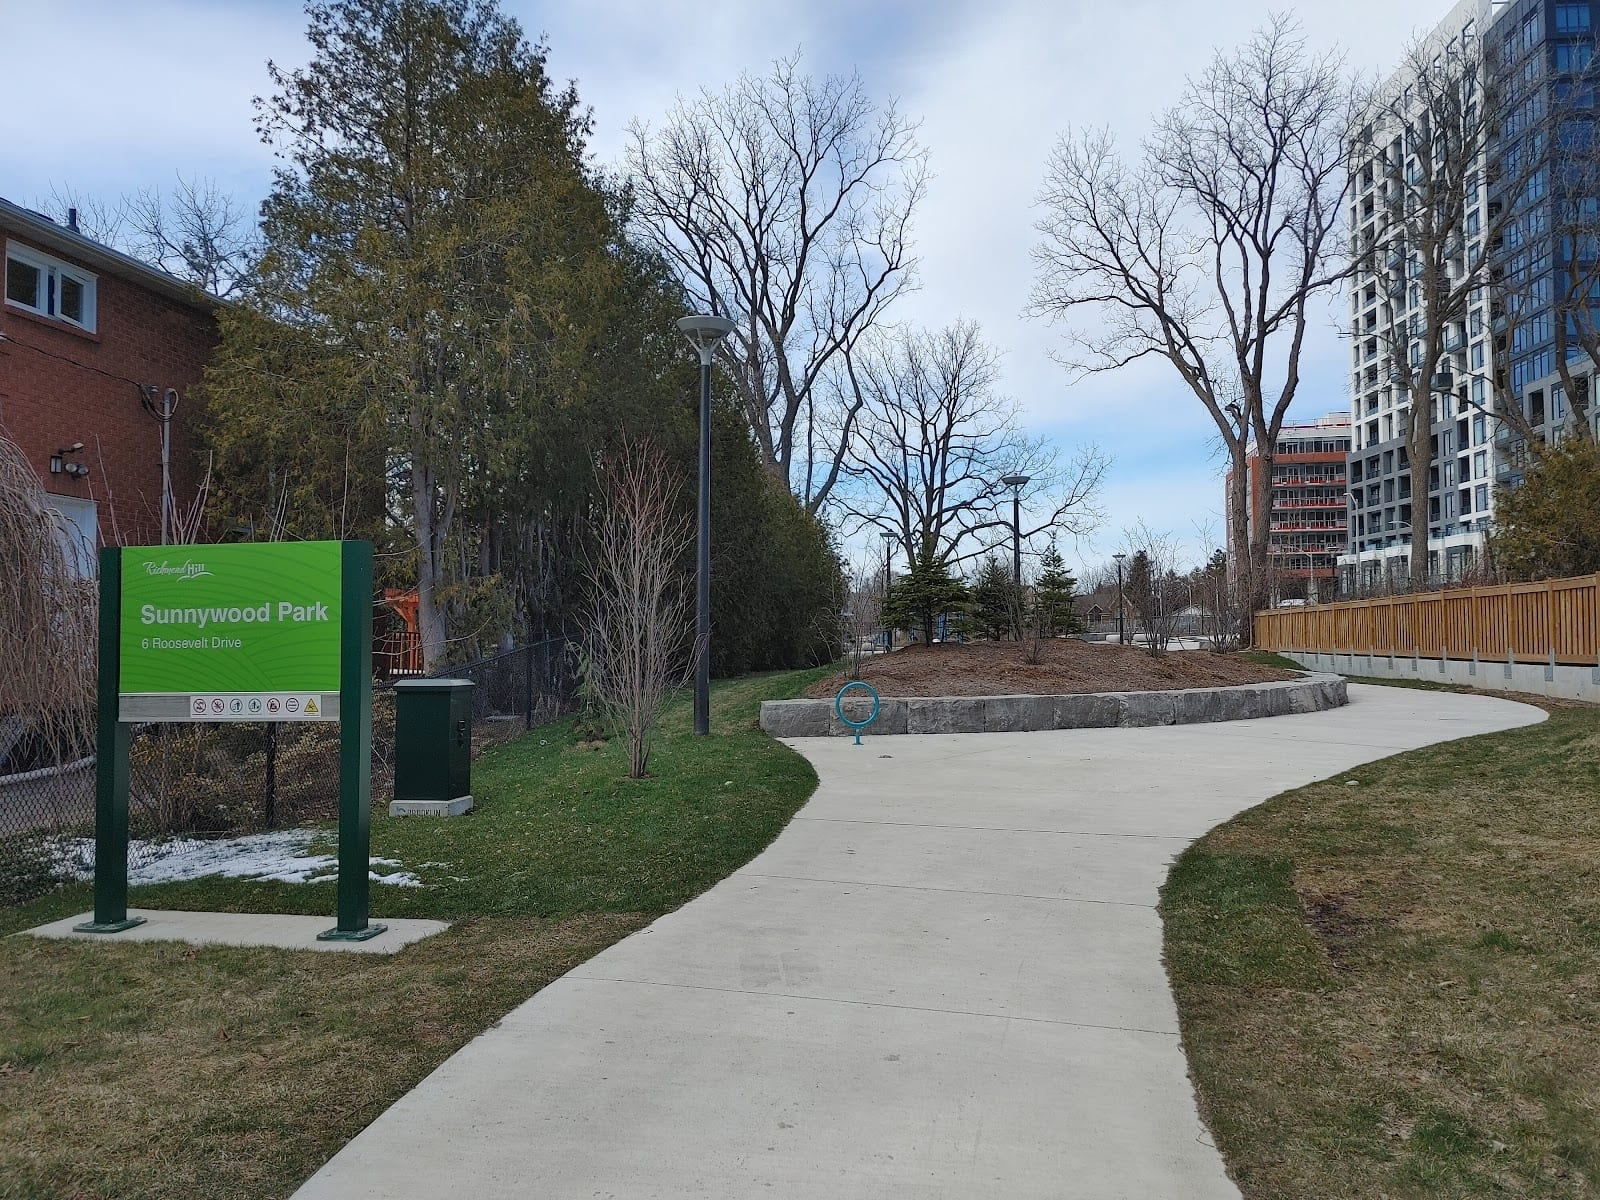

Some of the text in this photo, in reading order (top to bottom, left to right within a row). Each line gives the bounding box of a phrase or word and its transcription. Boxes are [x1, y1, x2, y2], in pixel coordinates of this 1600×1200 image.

[187, 563, 205, 576] Hill
[140, 601, 329, 628] Sunnywood Park
[141, 636, 242, 649] 6 Roosevelt Drive
